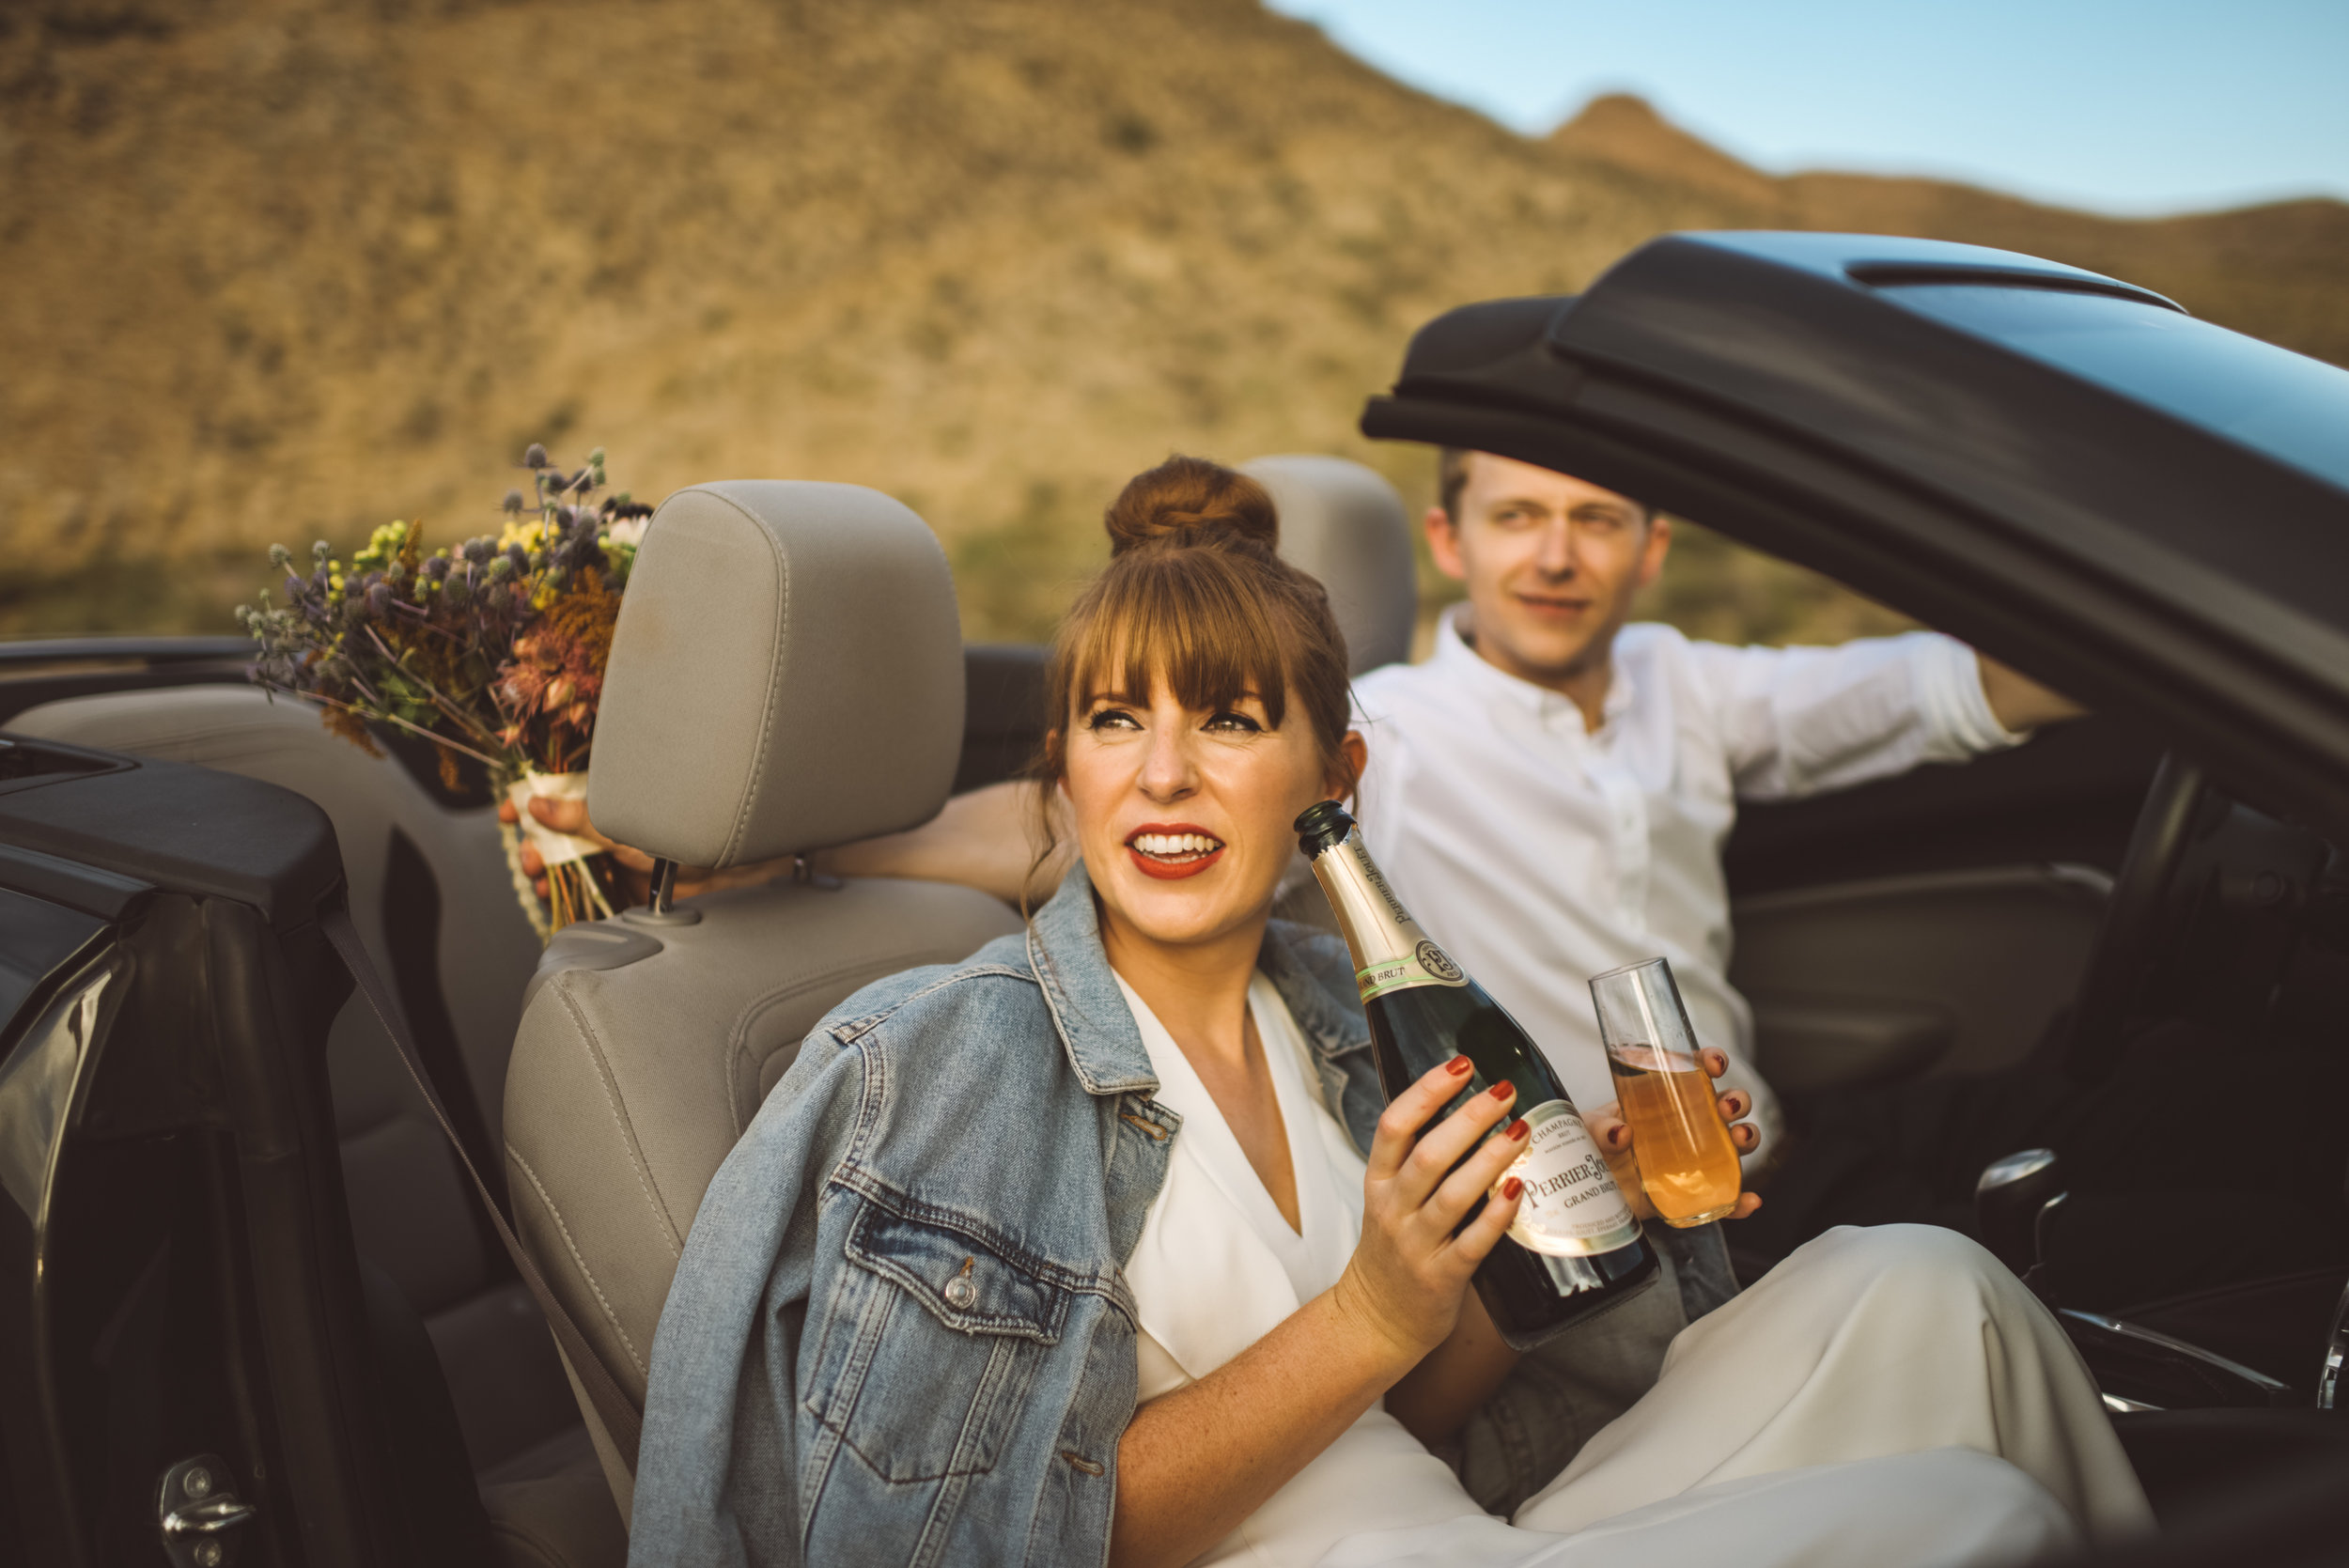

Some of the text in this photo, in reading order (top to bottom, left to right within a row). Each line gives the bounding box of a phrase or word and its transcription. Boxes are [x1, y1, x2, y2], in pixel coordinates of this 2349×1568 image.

[1377, 967, 1406, 982] BRUT
[1532, 1118, 1583, 1144] CHAMPAGNE
[1563, 1180, 1617, 1209] GRAND BRUT
